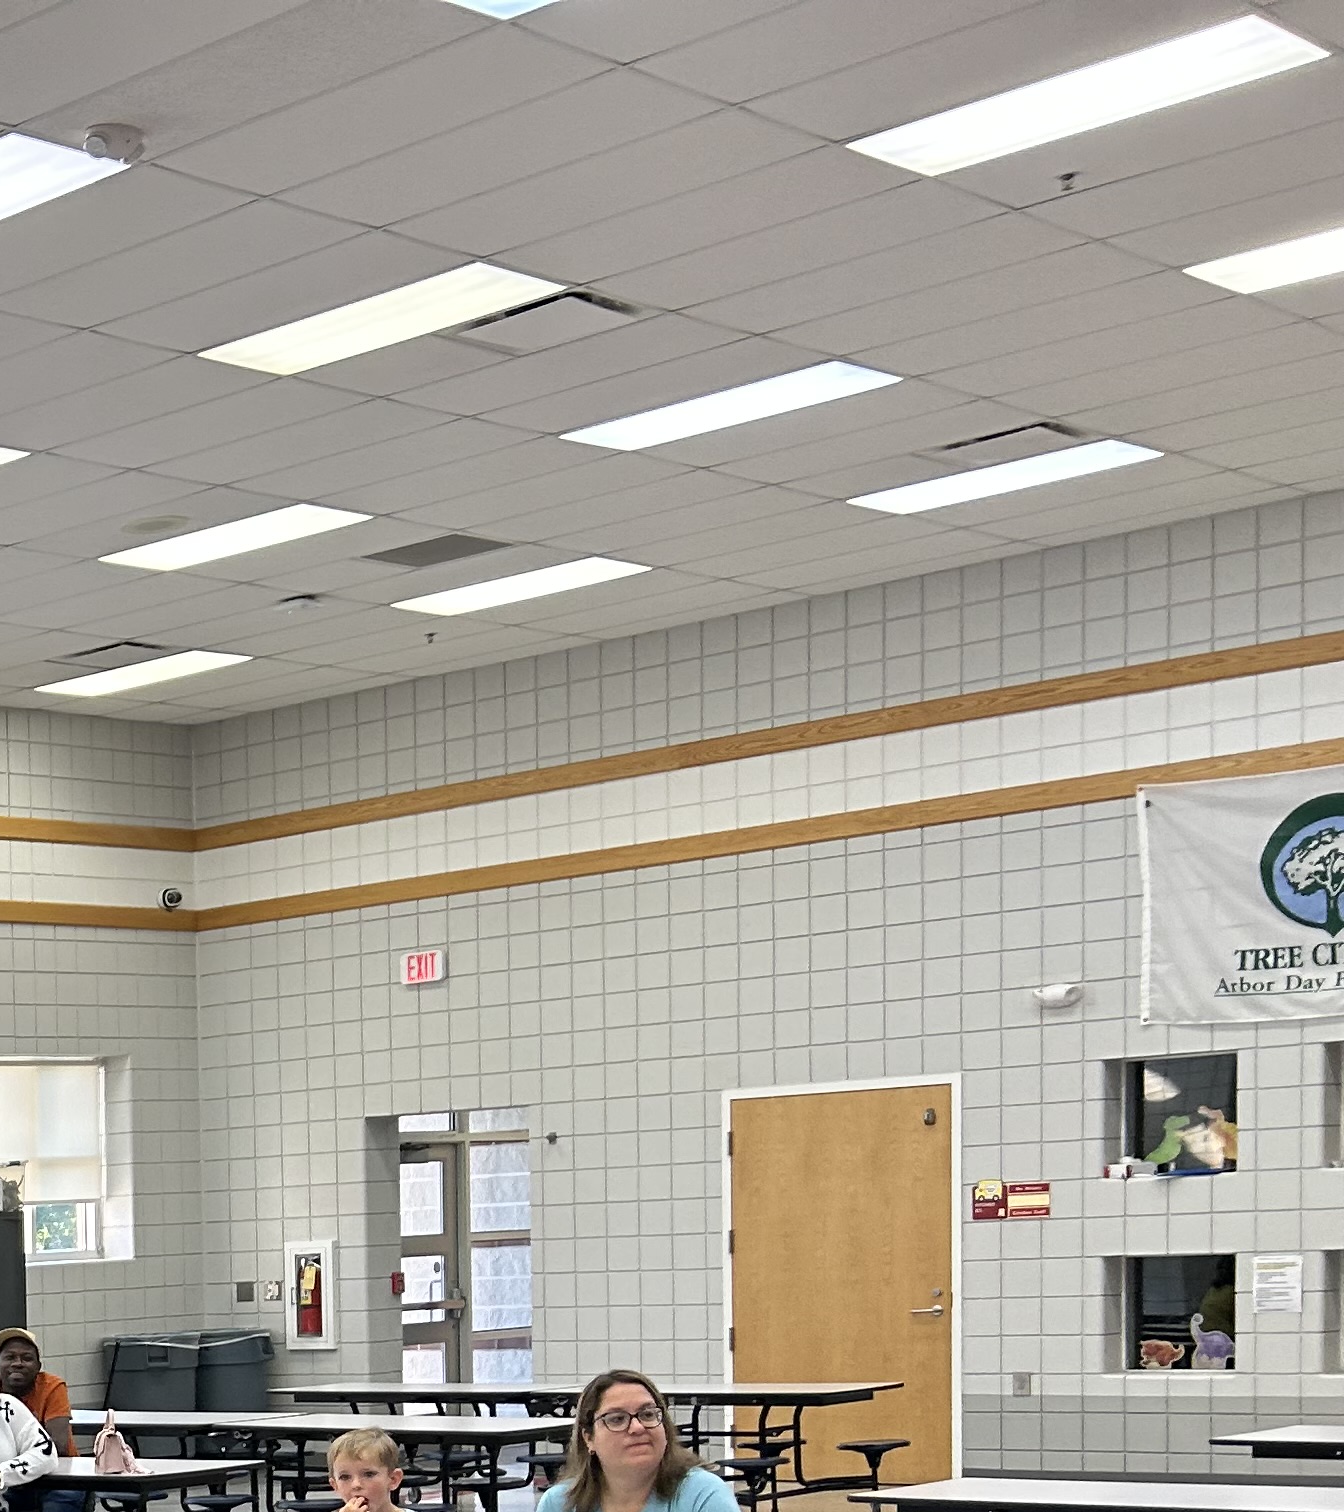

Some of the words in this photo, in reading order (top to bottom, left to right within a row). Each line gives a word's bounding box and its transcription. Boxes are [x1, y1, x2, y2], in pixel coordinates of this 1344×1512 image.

[407, 952, 437, 981] EXIT
[1234, 945, 1304, 971] TREE
[1214, 976, 1275, 994] Arbor
[1284, 974, 1326, 993] Day
